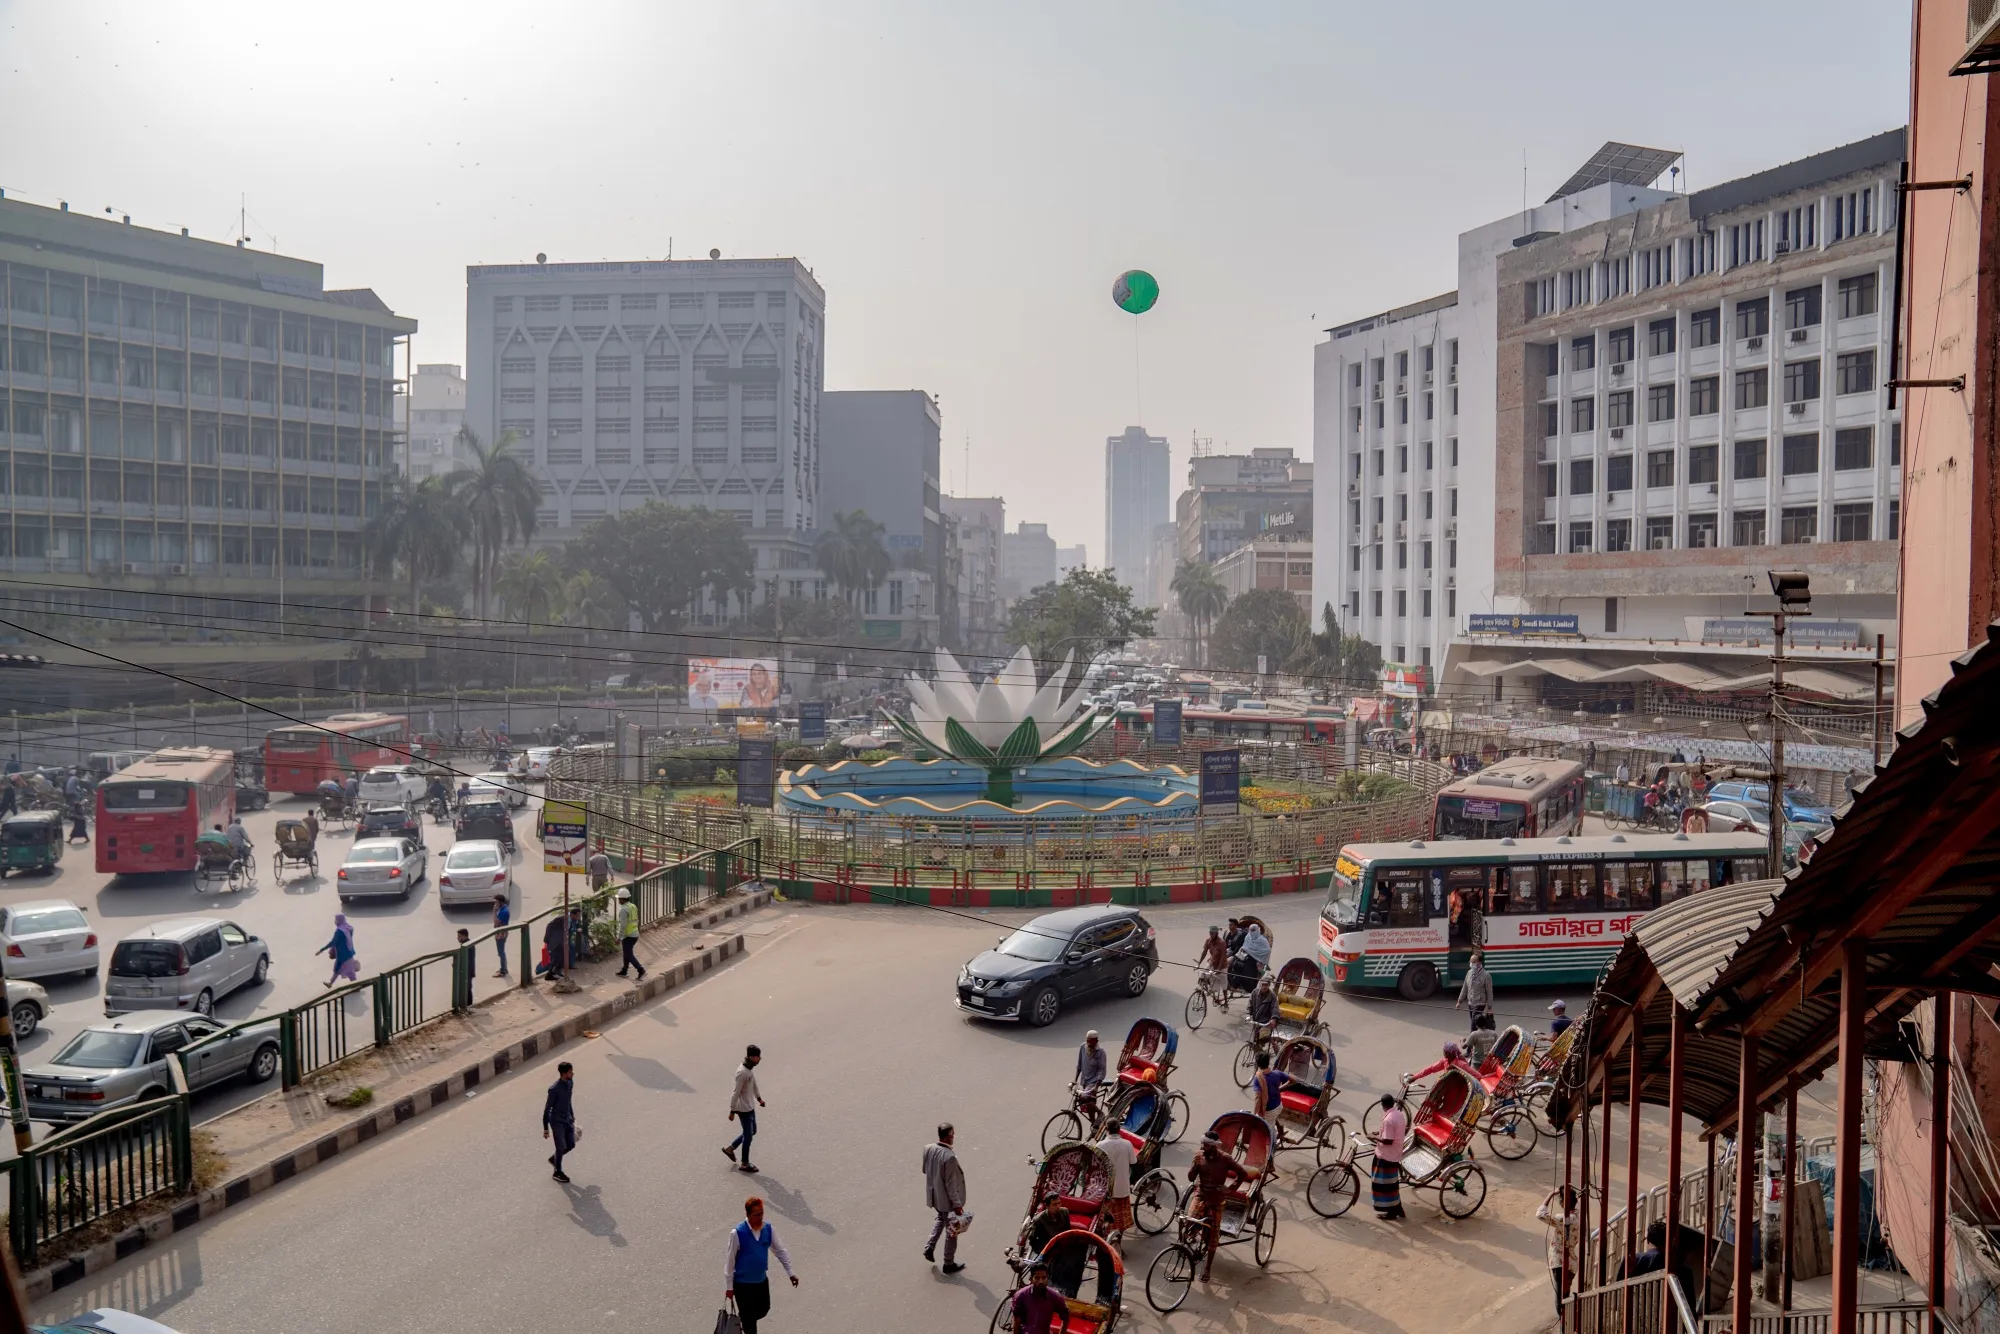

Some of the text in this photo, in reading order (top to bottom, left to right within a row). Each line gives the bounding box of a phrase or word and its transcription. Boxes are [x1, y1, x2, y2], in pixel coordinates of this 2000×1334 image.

[1269, 511, 1295, 527] MetLife
[1521, 619, 1537, 627] Sonali
[1553, 620, 1575, 628] Limited
[1828, 628, 1856, 637] Limited
[1518, 917, 1605, 938] গাজীপুর
